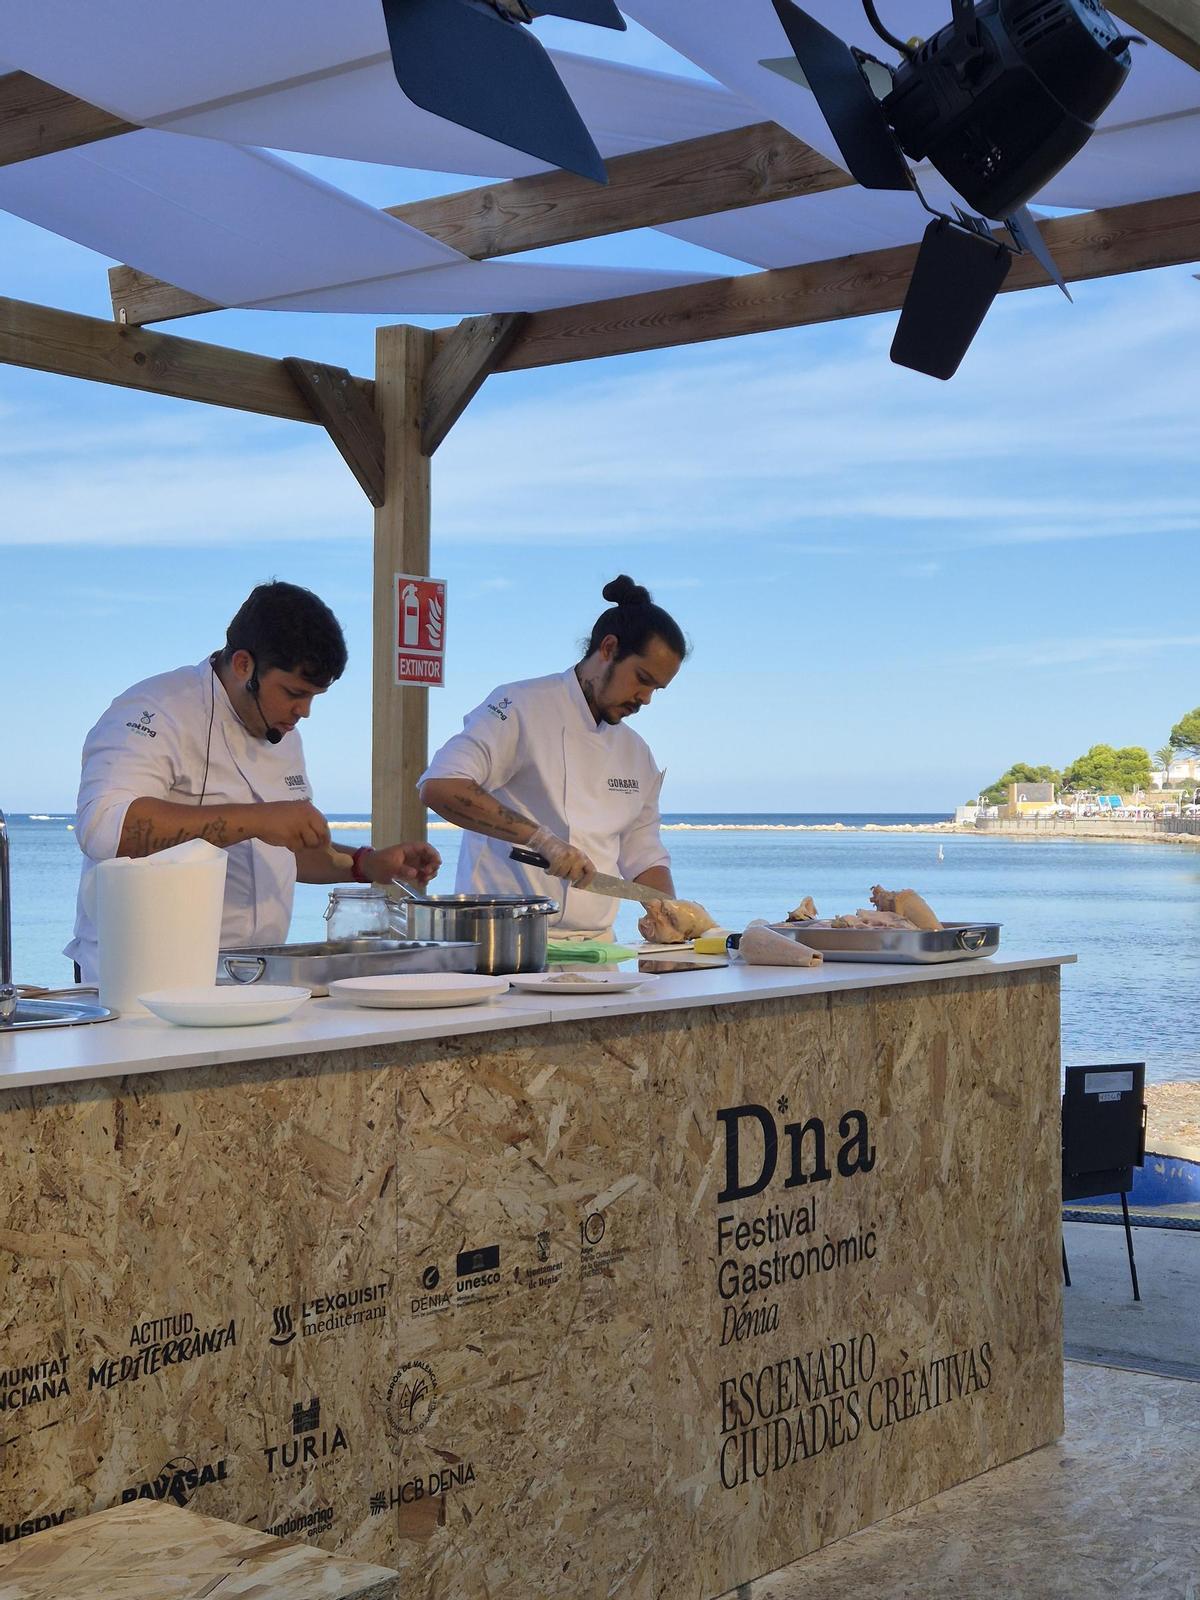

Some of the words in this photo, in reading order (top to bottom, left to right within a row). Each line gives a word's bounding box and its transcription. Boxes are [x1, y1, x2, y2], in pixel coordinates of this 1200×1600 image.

[399, 658, 441, 677] EXTINTOR
[717, 1196, 816, 1256] Festival
[456, 1272, 501, 1293] unesco
[718, 1223, 878, 1300] Gastronòmic
[129, 1312, 194, 1347] ACTITUD
[302, 1303, 387, 1338] mediterrani
[719, 1299, 780, 1347] Dénia
[719, 1332, 877, 1436] ESCENARIO
[719, 1390, 861, 1491] CIUDADES
[867, 1341, 993, 1432] CREATIVAS
[264, 1427, 348, 1472] TURIA
[307, 1522, 333, 1537] GRUPO
